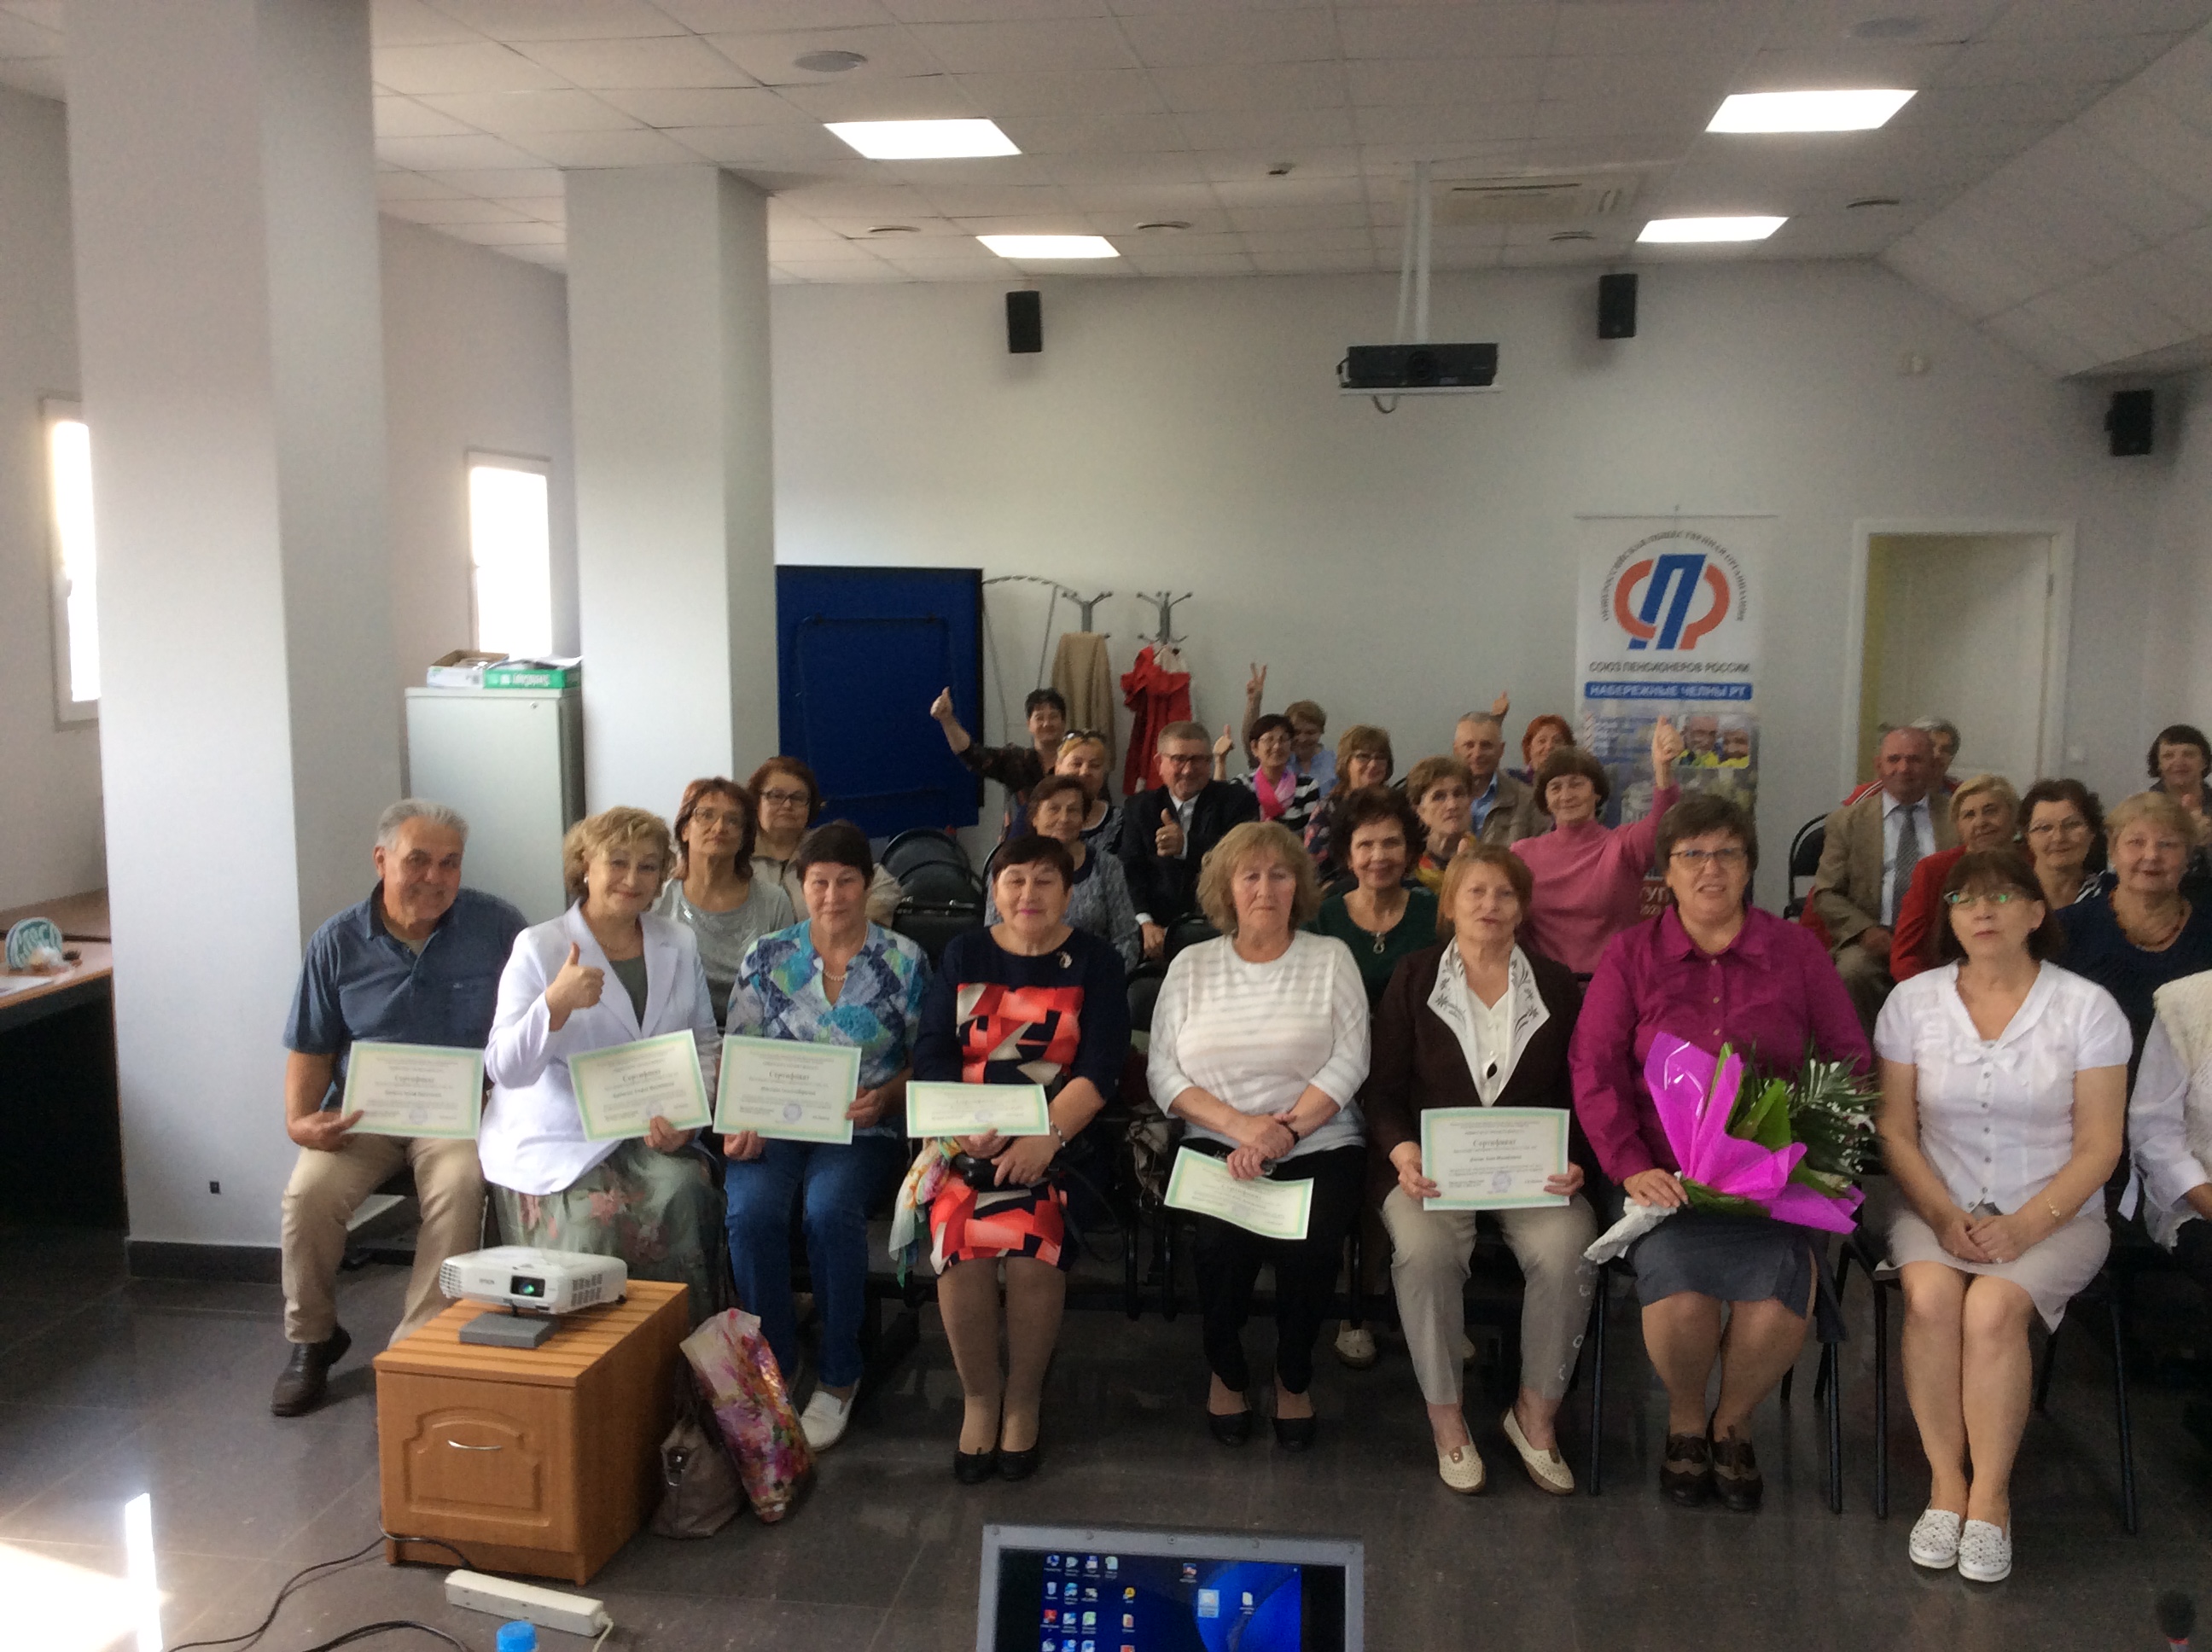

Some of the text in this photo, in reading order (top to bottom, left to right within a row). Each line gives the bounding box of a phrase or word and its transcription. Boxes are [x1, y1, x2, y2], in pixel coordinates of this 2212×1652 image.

[1589, 661, 1750, 673] СОЮЗ ПЕНСИОНЕРОВ РОССИИ
[1590, 684, 1746, 697] НАБЕРЕЖНЫЕ ЧЕЛНЫ РТ
